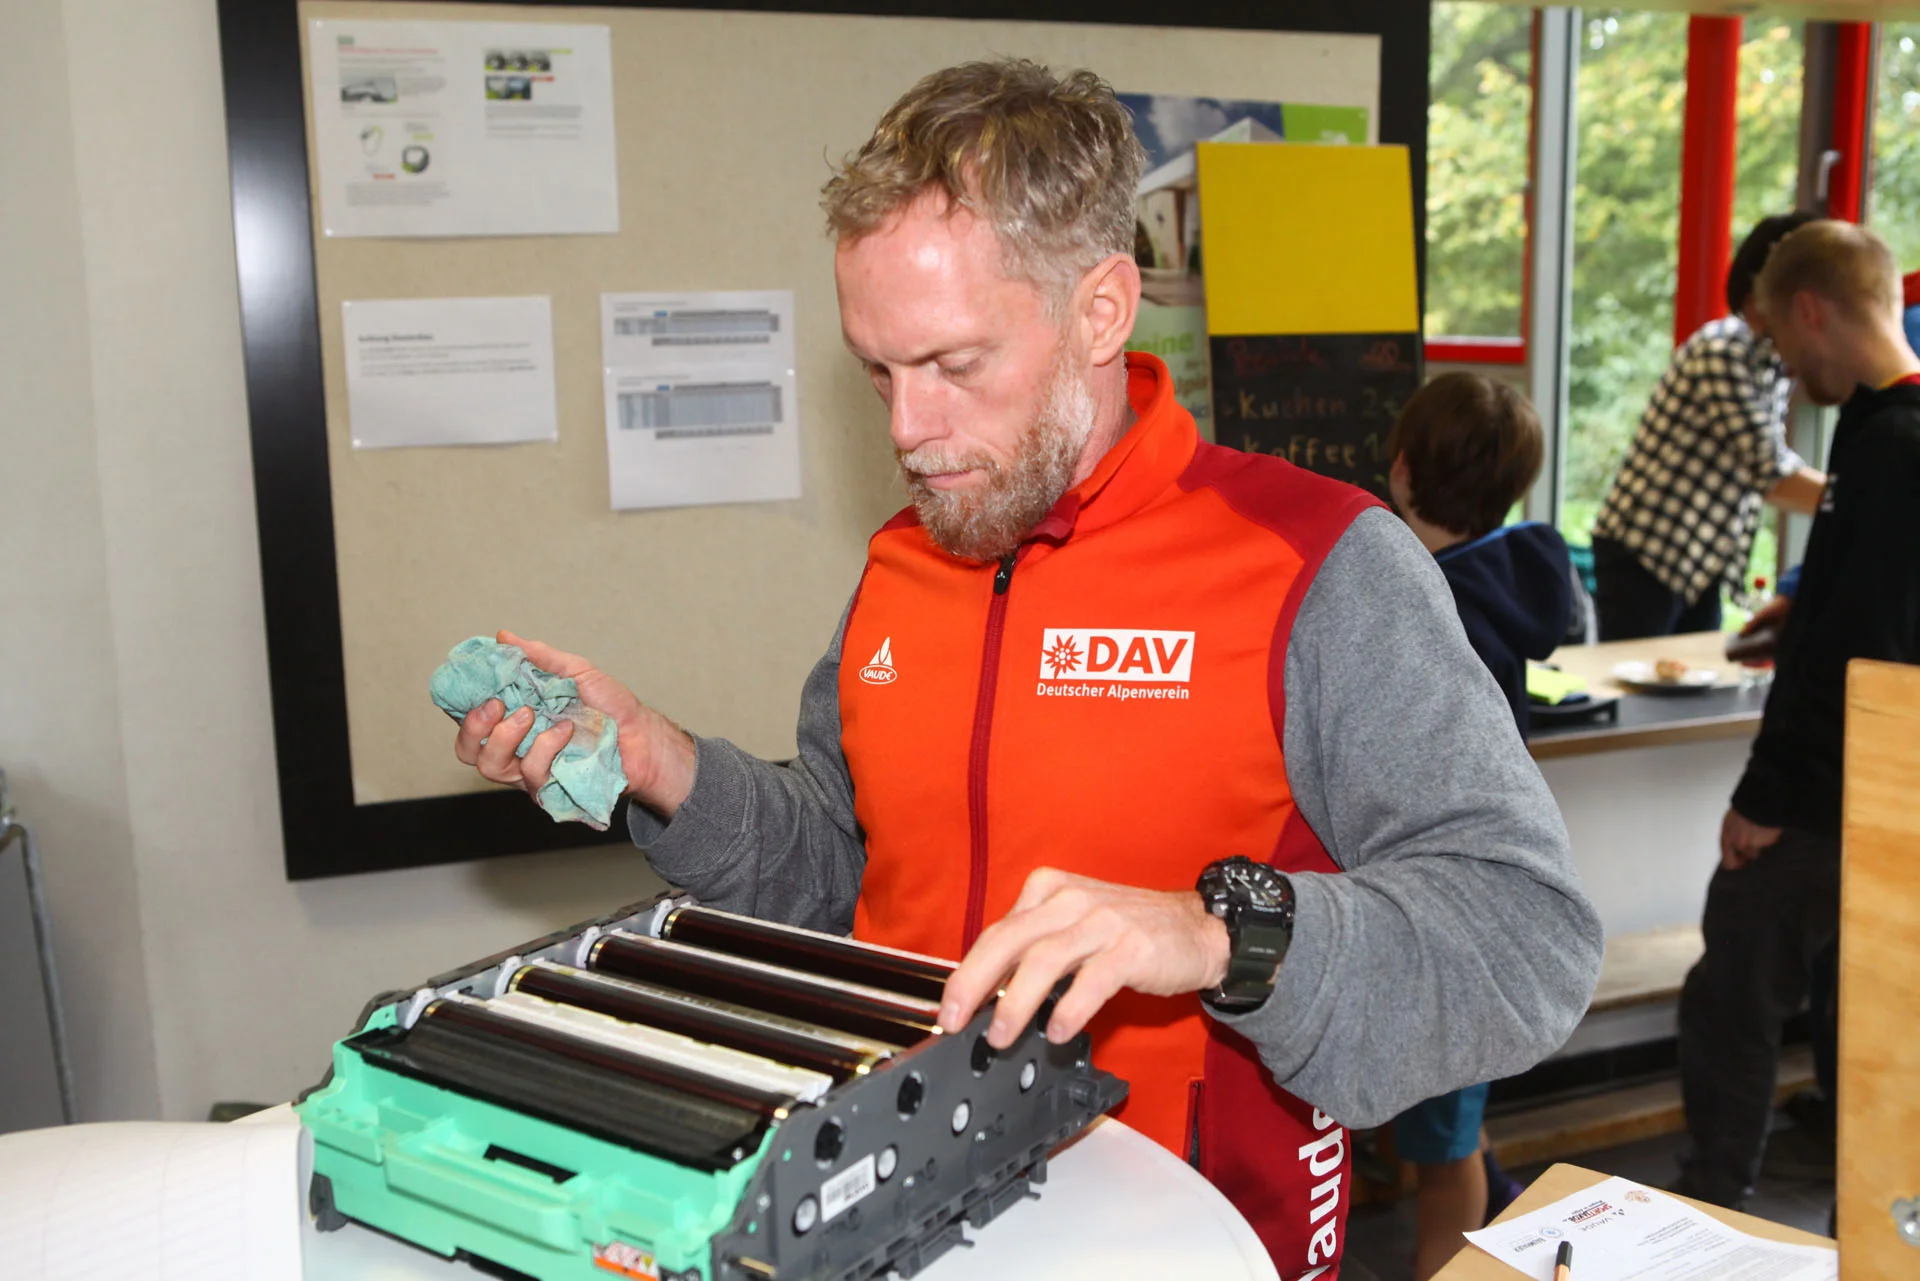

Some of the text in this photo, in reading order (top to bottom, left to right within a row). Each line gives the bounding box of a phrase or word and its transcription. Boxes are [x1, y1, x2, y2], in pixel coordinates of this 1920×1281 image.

[1086, 635, 1189, 675] DAV
[863, 667, 894, 681] VAUDE
[1036, 682, 1190, 701] Deutscher Alpenverein
